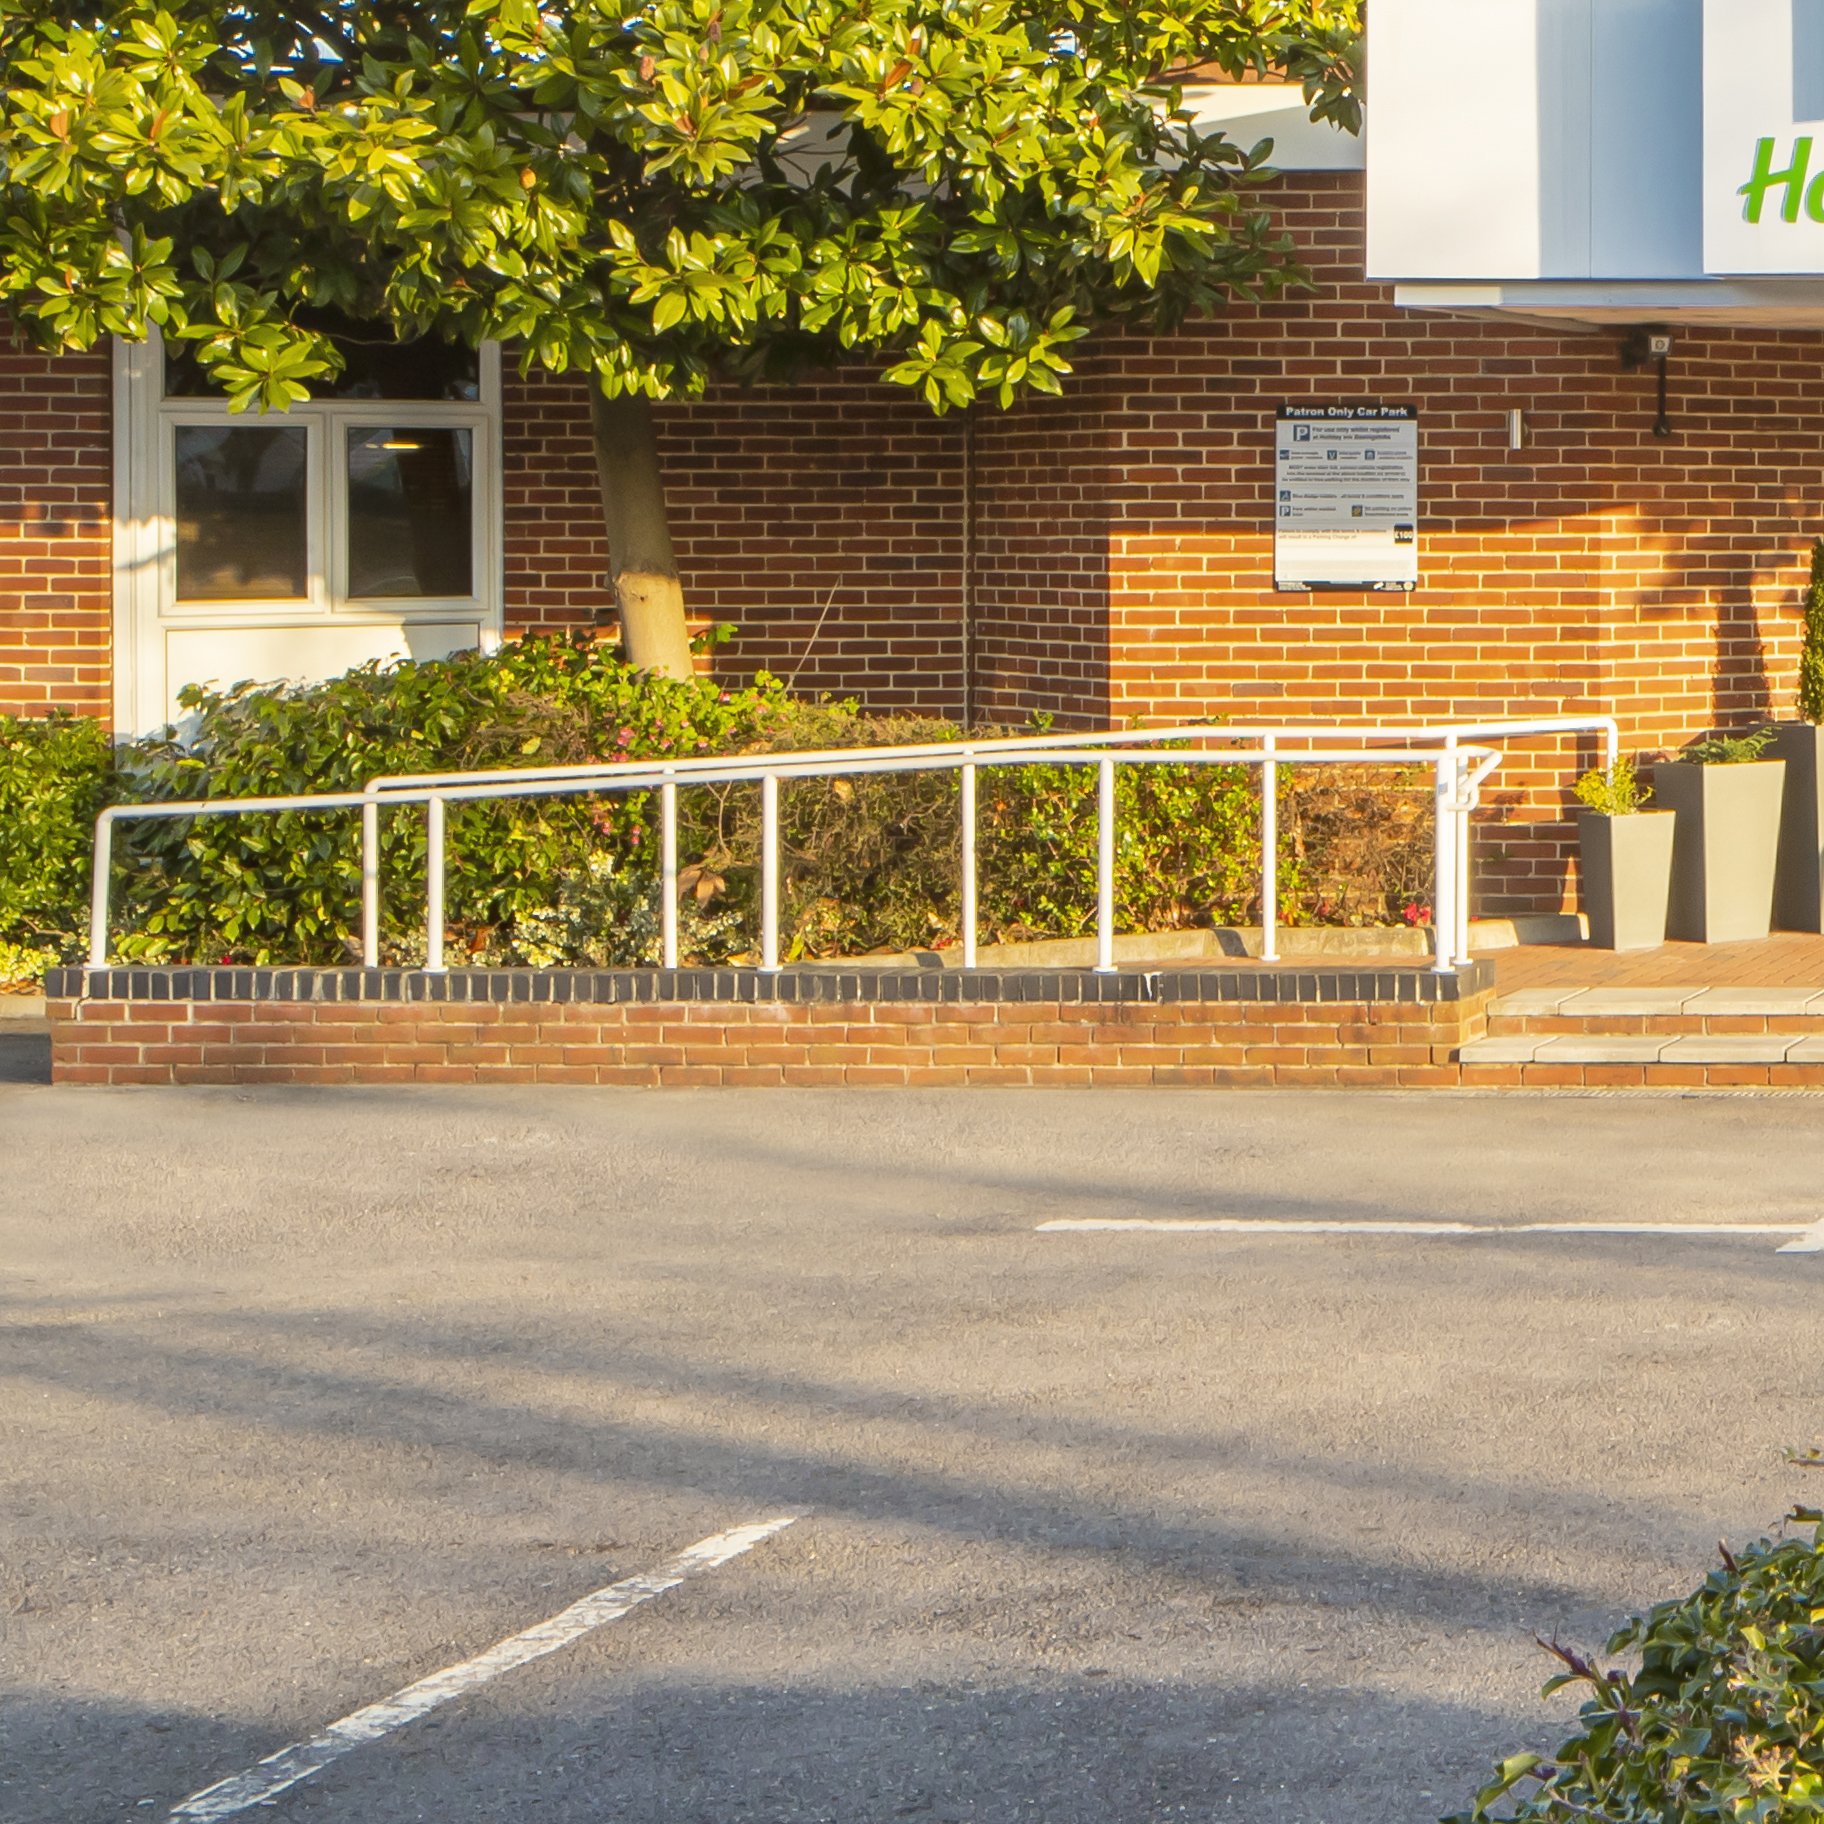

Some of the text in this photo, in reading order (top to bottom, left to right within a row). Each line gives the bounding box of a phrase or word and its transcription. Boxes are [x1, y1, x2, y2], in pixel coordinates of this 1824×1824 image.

[1286, 407, 1408, 418] Patron Only Car Park
